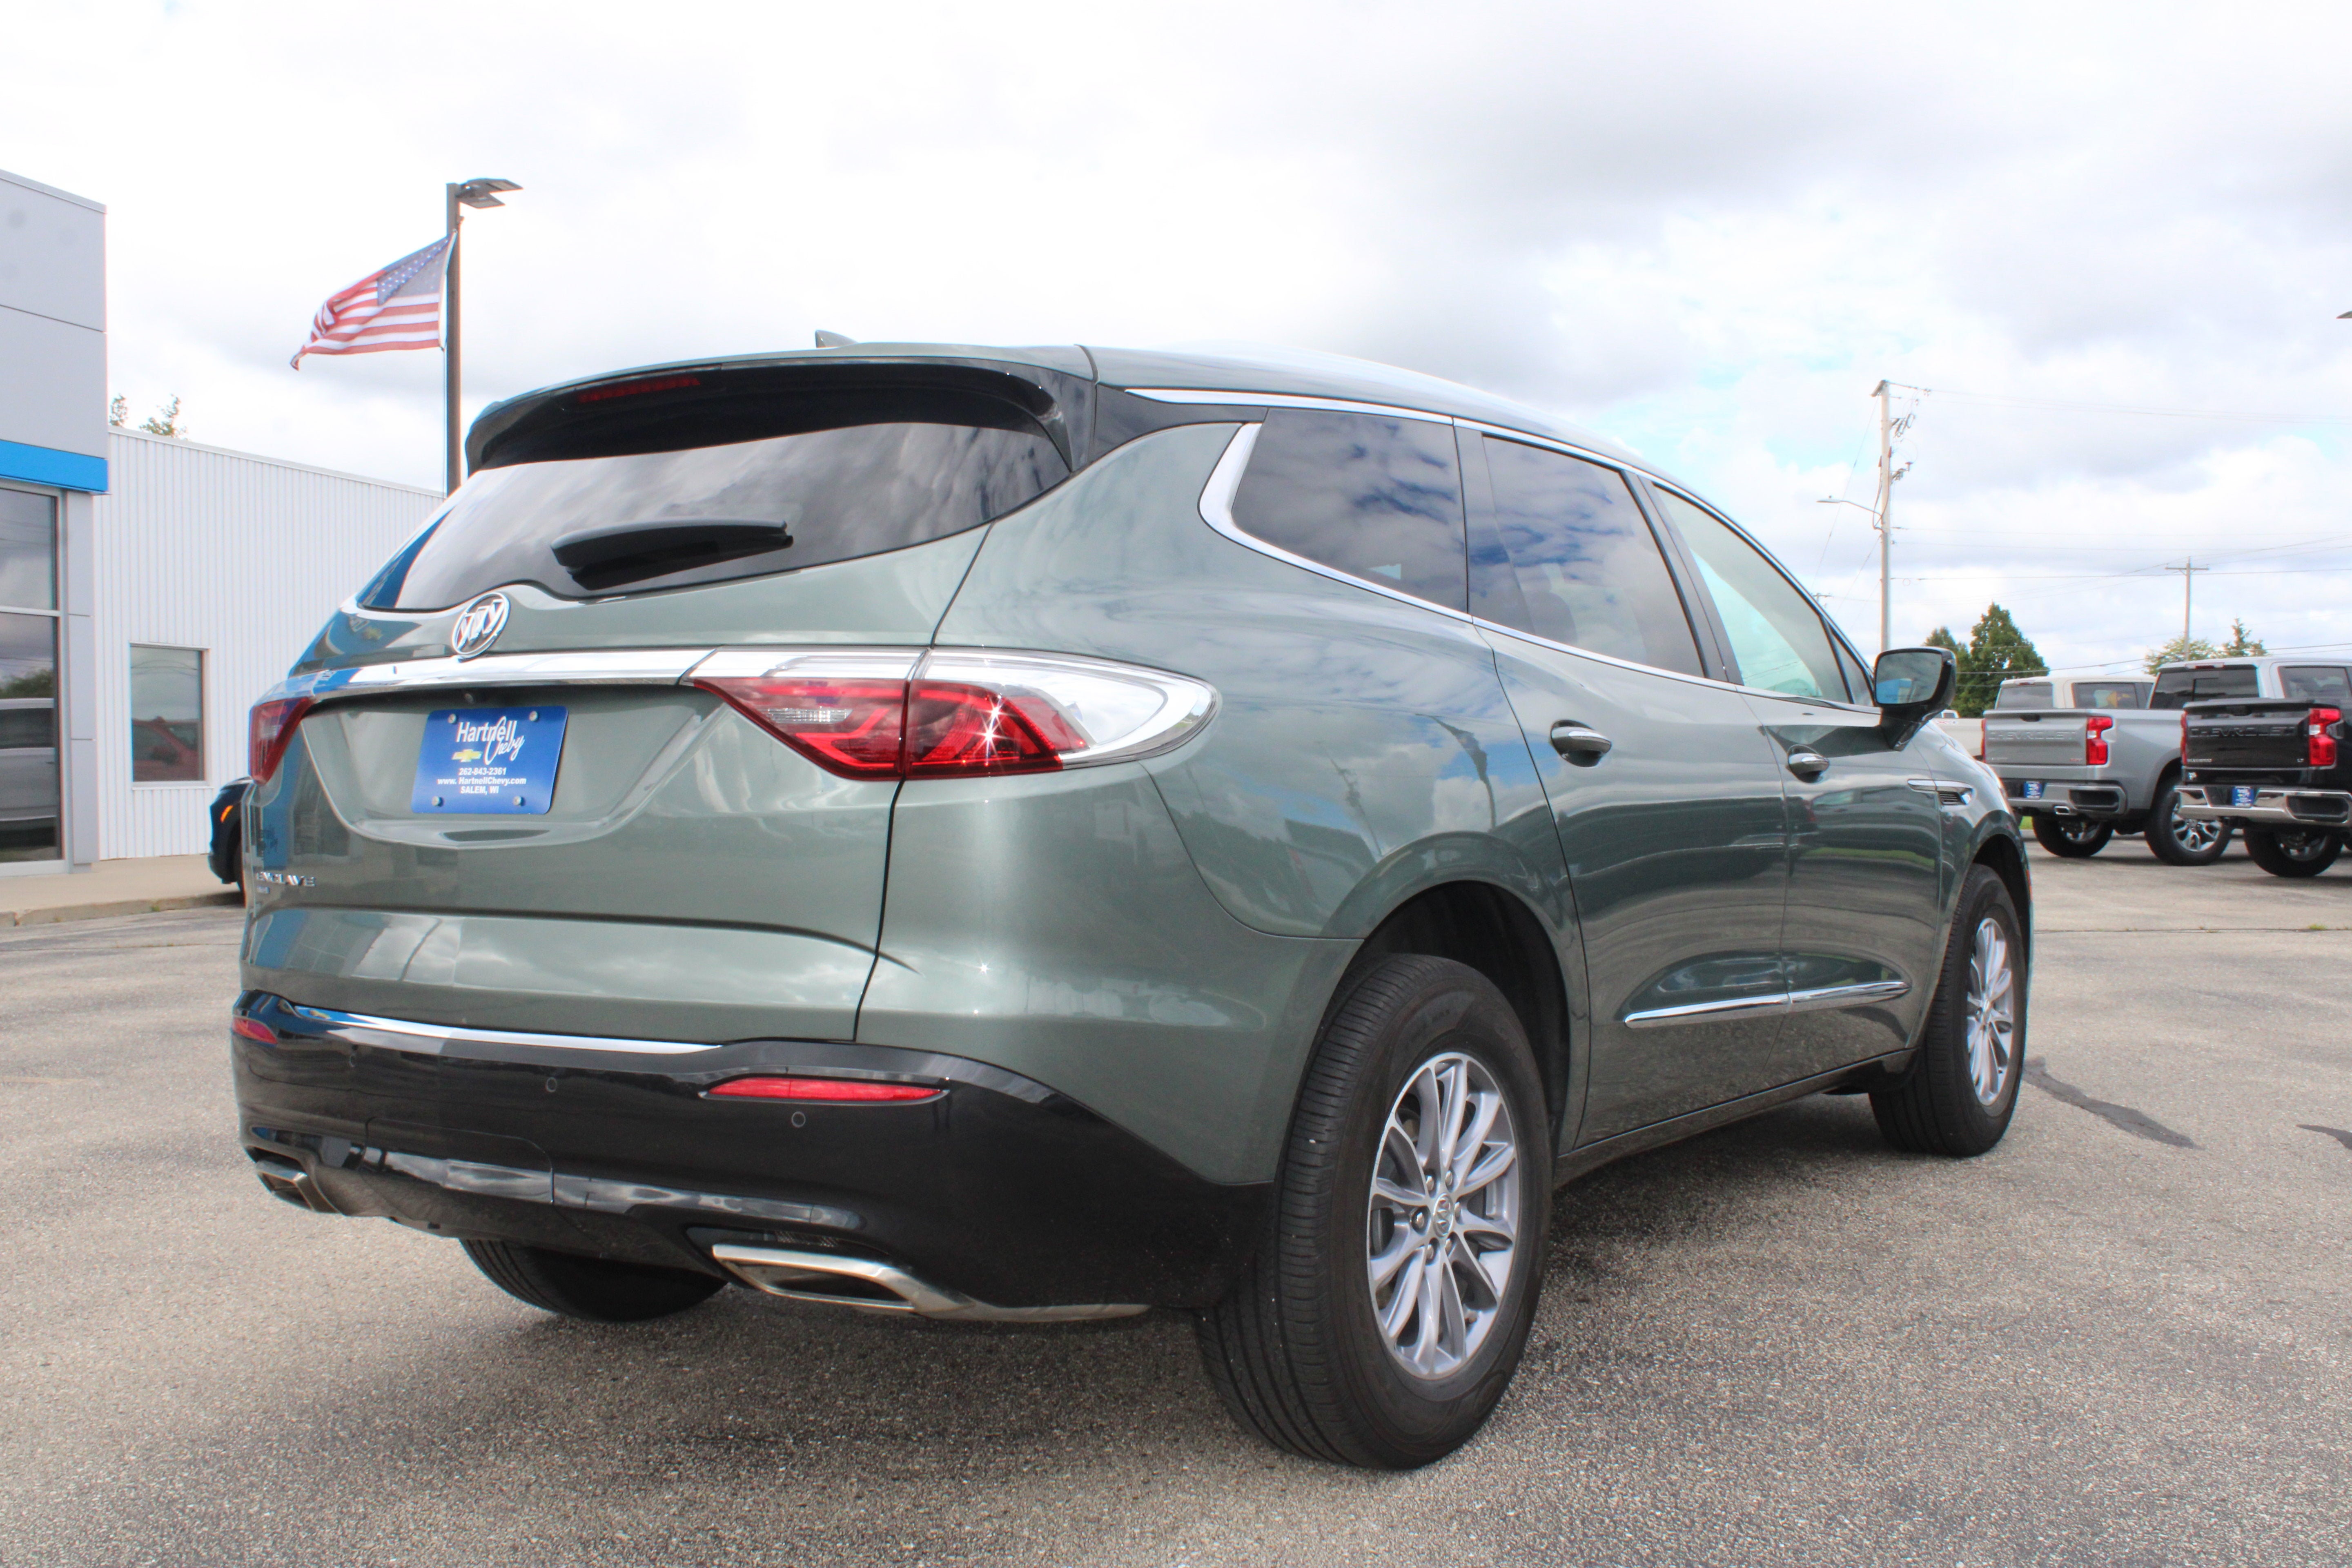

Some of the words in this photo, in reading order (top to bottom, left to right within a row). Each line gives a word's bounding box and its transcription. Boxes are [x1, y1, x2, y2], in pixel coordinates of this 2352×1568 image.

[456, 720, 517, 743] Hartnell
[2188, 726, 2296, 737] CHEVROLET
[483, 716, 525, 766] Chevy
[458, 767, 507, 776] 262-843-2361
[458, 776, 527, 786] HartnellChevy.com
[460, 786, 488, 795] SALEM,
[490, 786, 499, 794] WI
